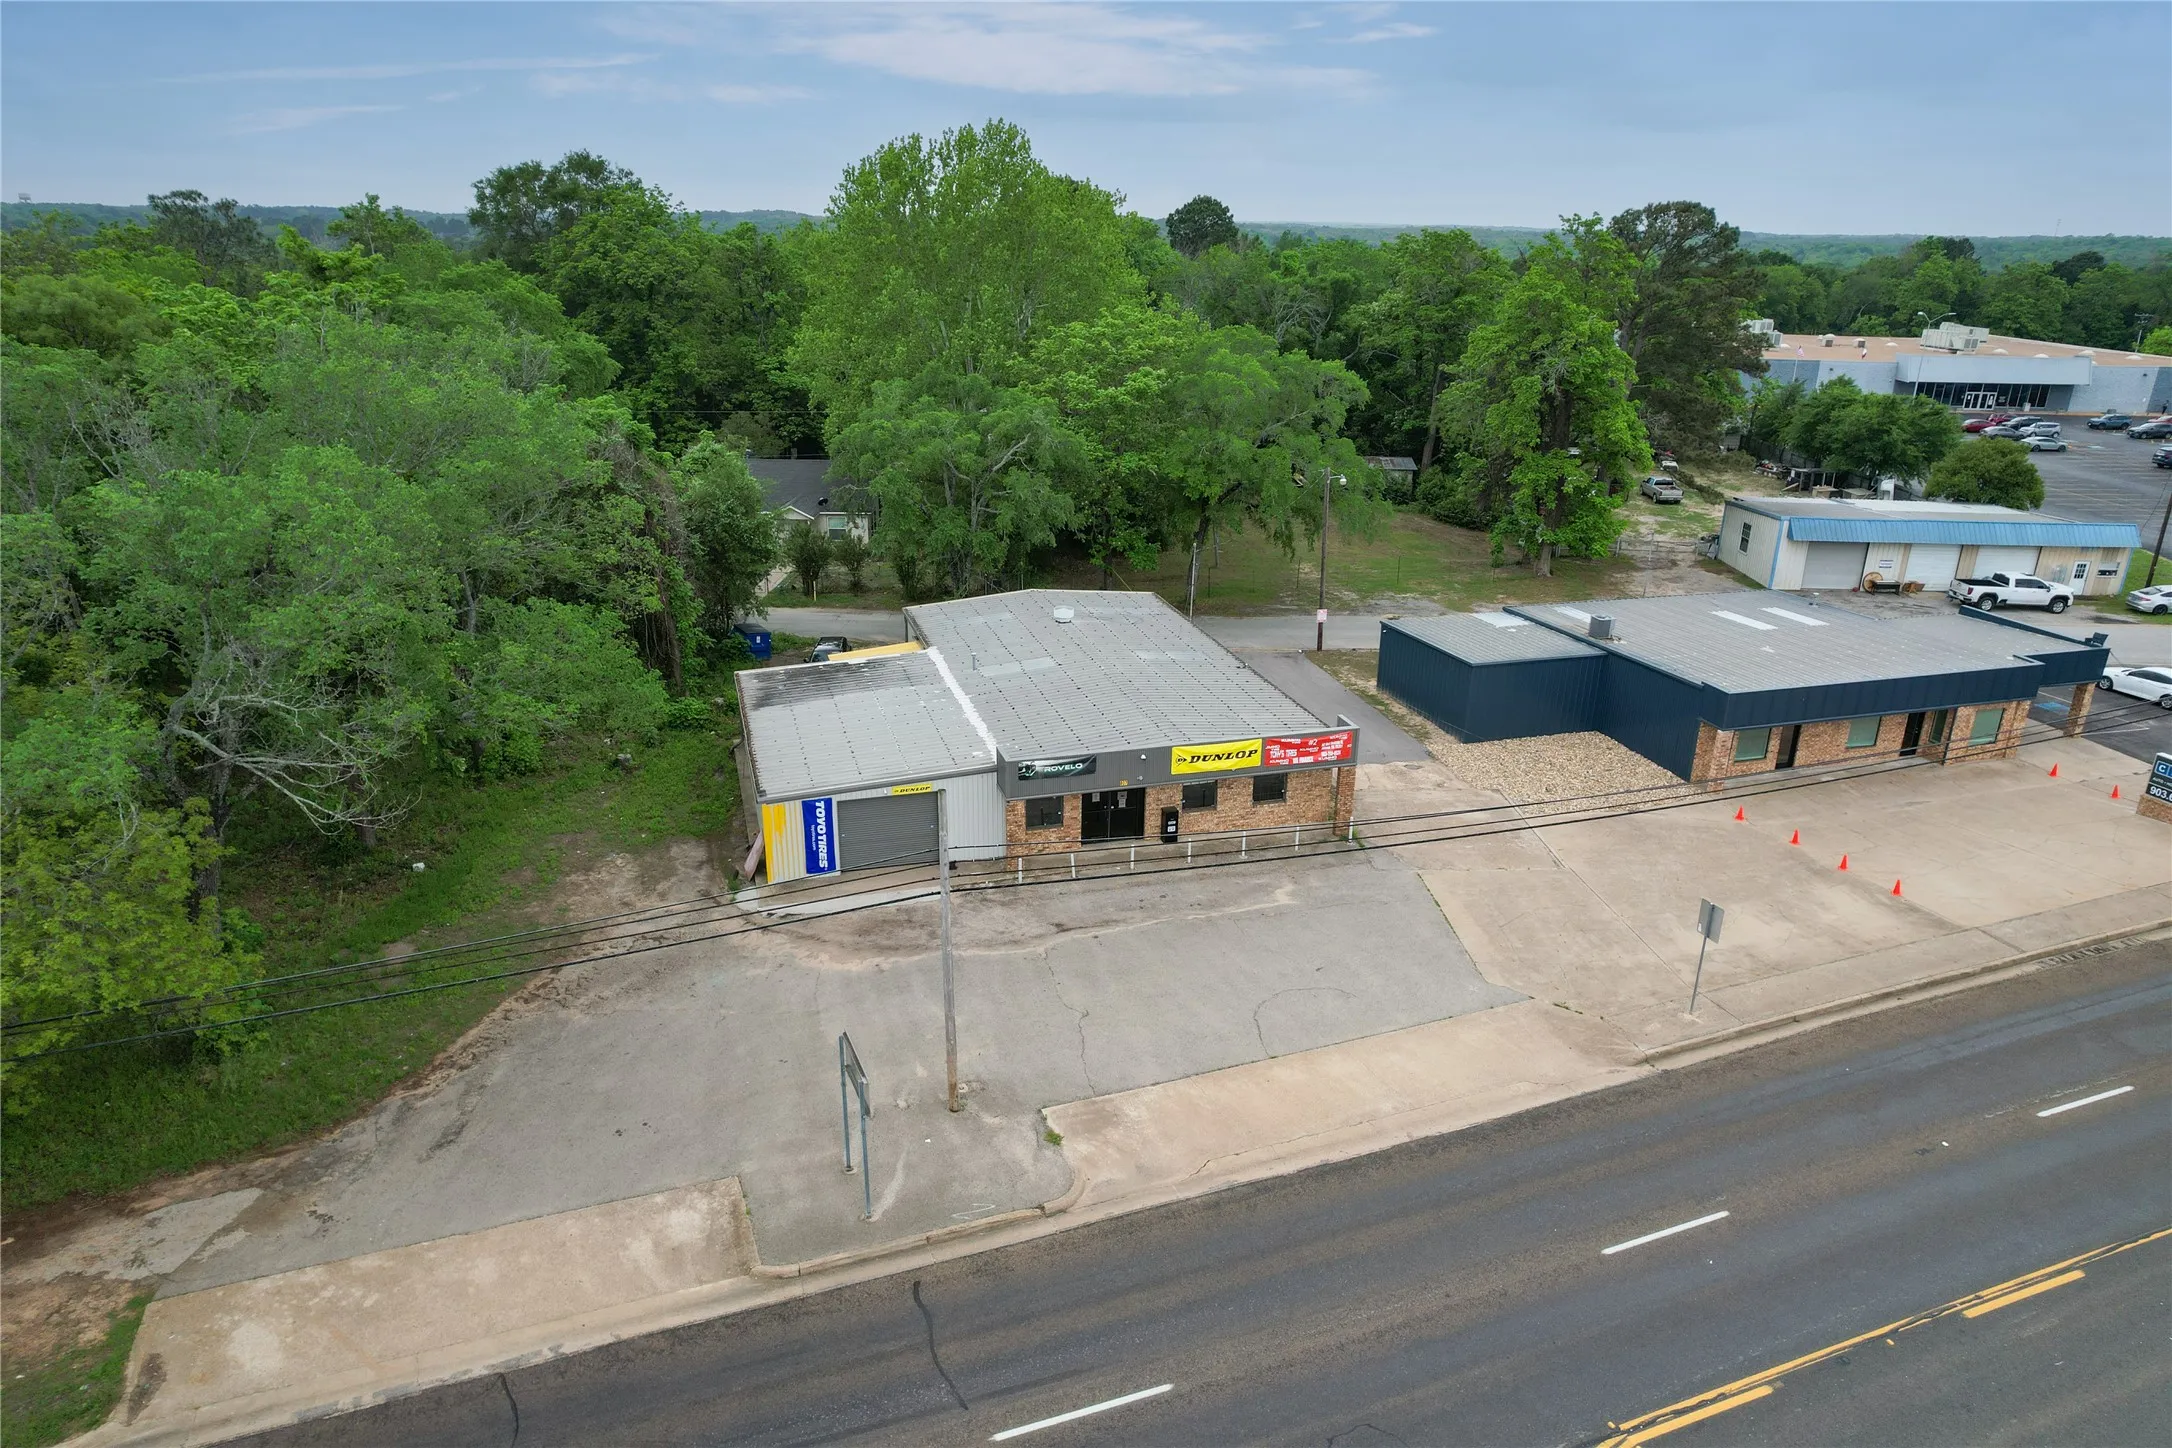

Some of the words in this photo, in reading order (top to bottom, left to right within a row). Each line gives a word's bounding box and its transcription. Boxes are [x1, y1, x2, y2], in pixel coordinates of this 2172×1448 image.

[1043, 763, 1083, 772] ROVELO
[1188, 749, 1258, 764] DUNLOP
[815, 801, 827, 834] TOYO
[817, 834, 828, 868] TIRES
